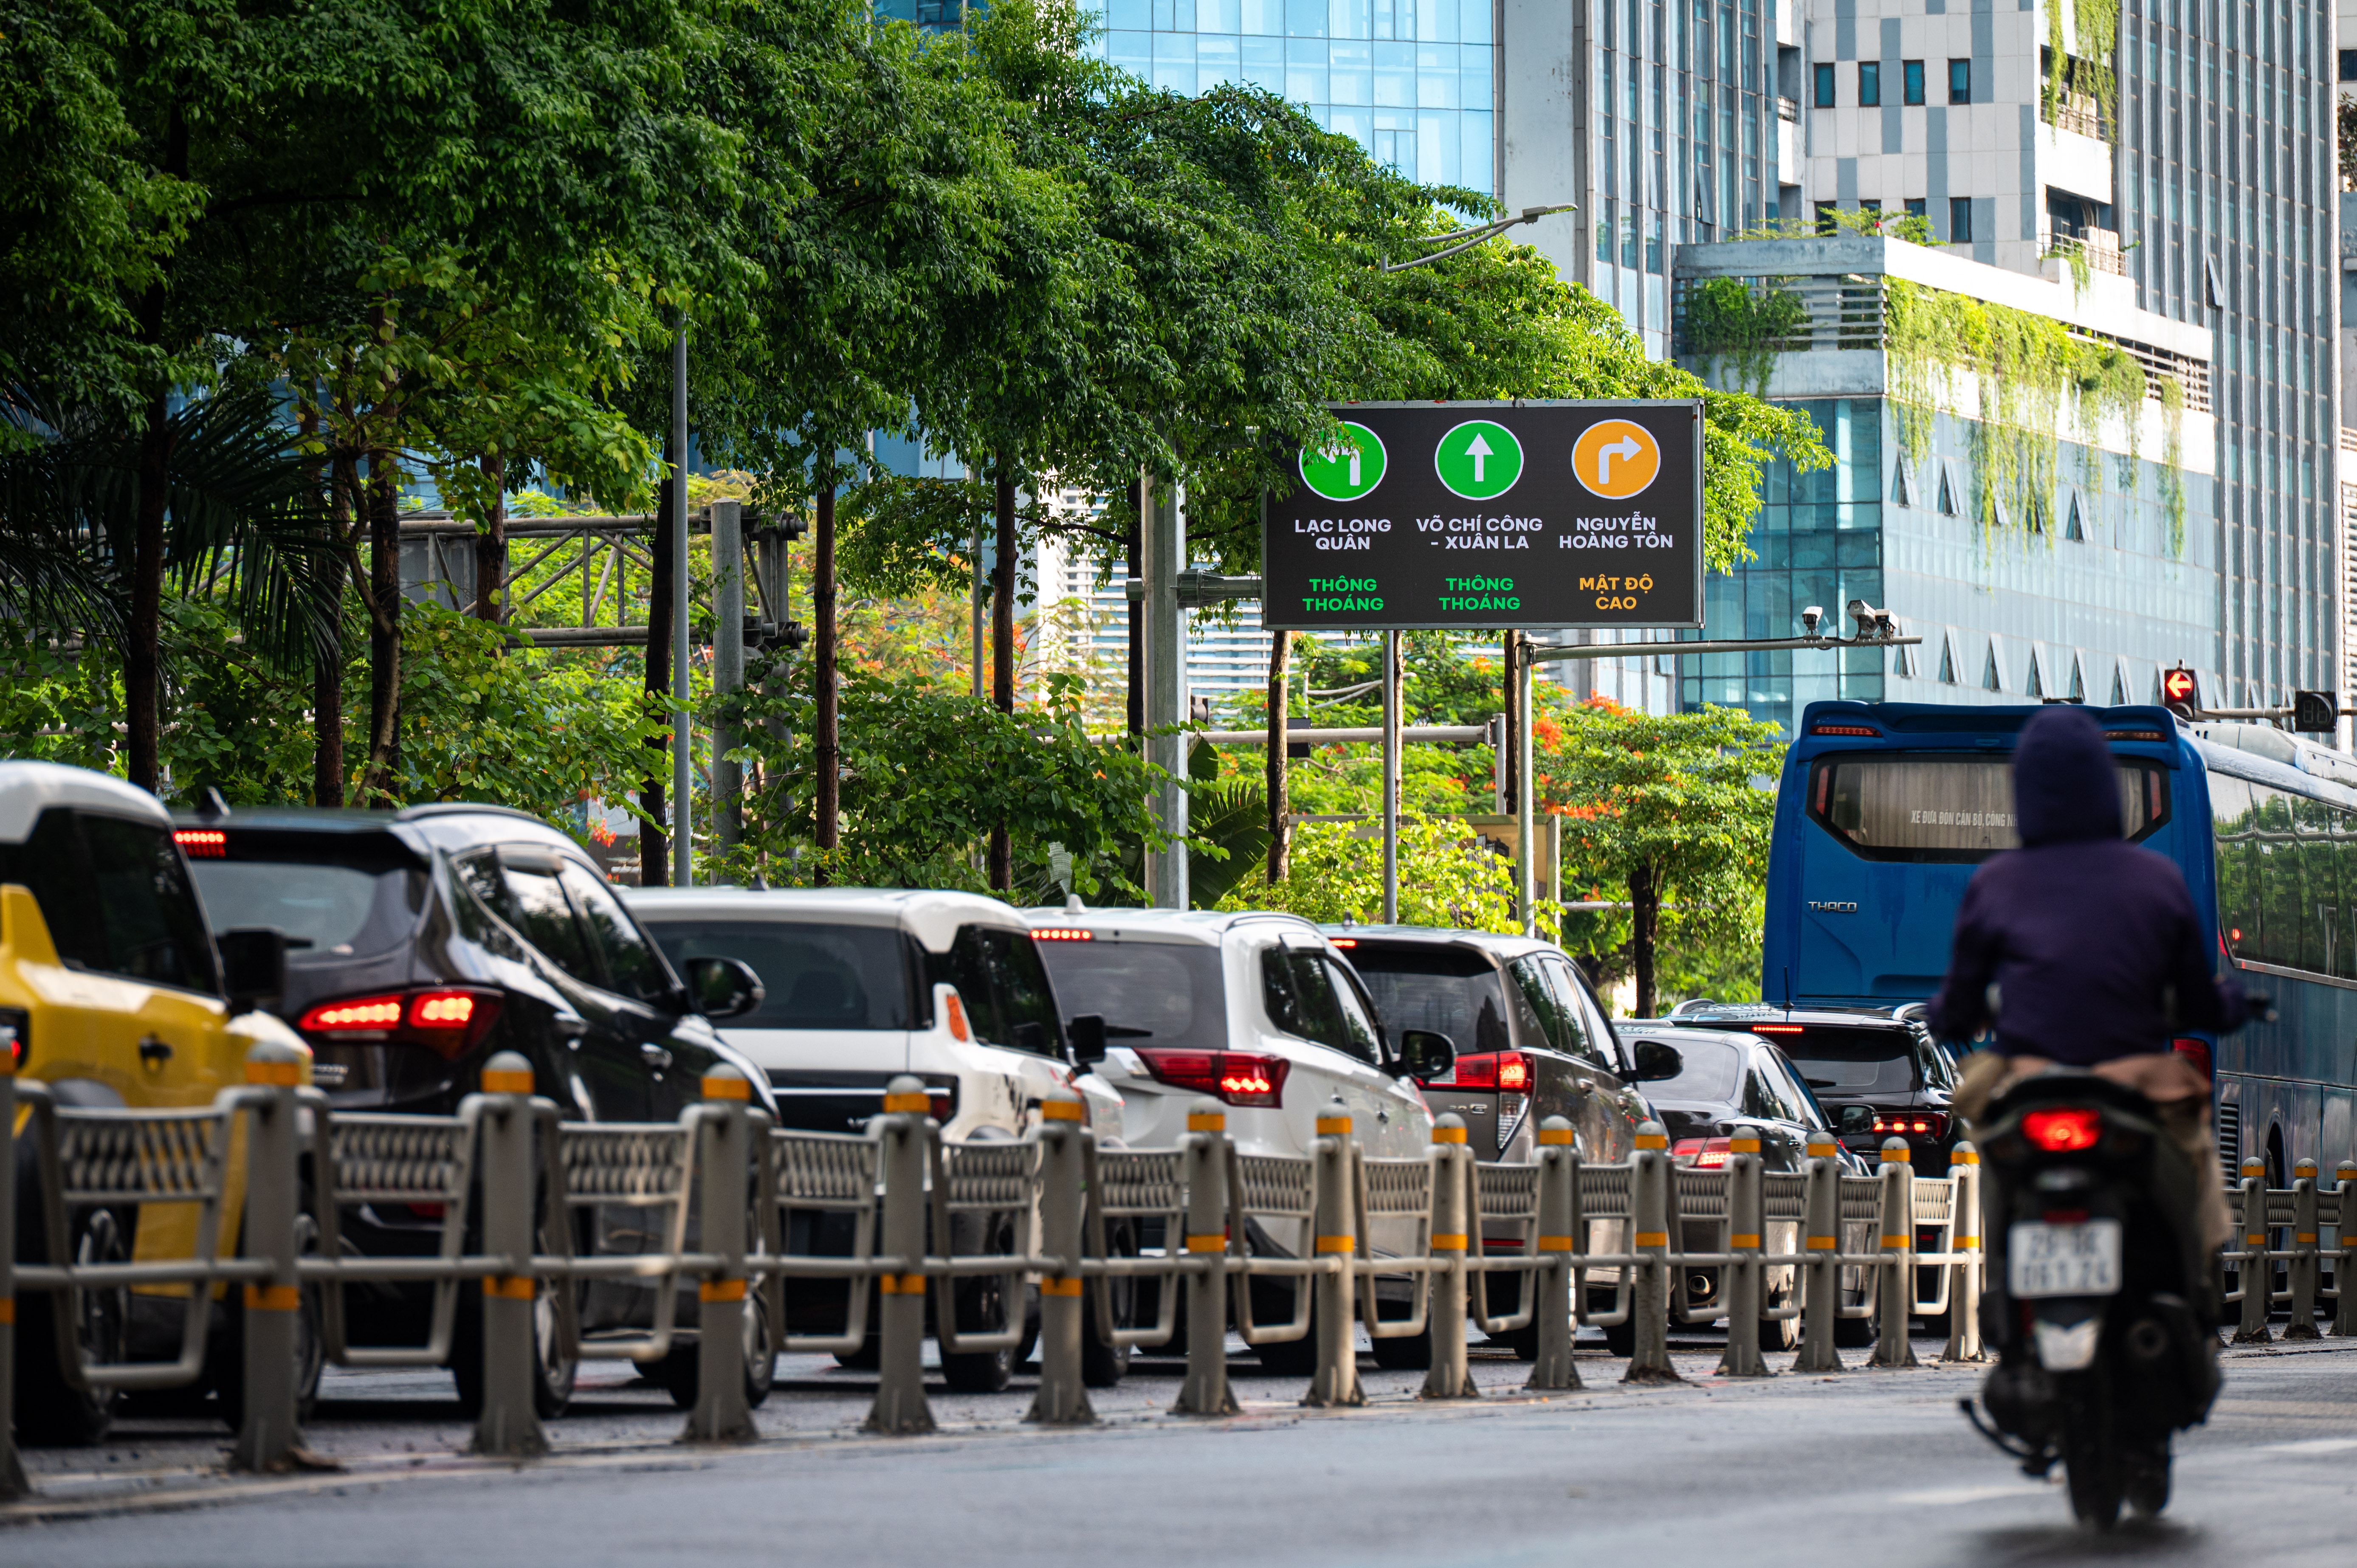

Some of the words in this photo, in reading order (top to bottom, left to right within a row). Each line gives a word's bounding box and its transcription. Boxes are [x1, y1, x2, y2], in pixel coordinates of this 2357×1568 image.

[1295, 519, 1333, 536] LẠC
[1339, 519, 1391, 532] LONG
[1416, 515, 1444, 532] VÕ
[1449, 515, 1481, 532] CHÍ
[1486, 515, 1542, 532] CÔNG
[1576, 511, 1656, 531] NGUYỄN
[1315, 533, 1370, 550] QUÂN
[1445, 532, 1499, 549] XUÂN
[1504, 535, 1529, 549] LA
[1559, 531, 1628, 549] HOÀNG
[1633, 531, 1673, 548] TÔN
[1309, 575, 1377, 591] THÔNG
[1446, 575, 1514, 591] THÔNG
[1579, 574, 1619, 594] MẬT
[1624, 574, 1653, 594] ĐỘ
[1303, 595, 1384, 611] THOÁNG
[1439, 594, 1520, 610] THOÁNG
[1596, 596, 1637, 610] CAO
[1911, 810, 1921, 823] XE
[1922, 810, 1937, 824] ĐƯA
[1939, 809, 1954, 825] ĐÓN
[1956, 810, 1971, 826] CÁN
[1985, 811, 2005, 827] CÔNG
[2007, 814, 2018, 827] NH
[1808, 901, 1857, 912] THACO
